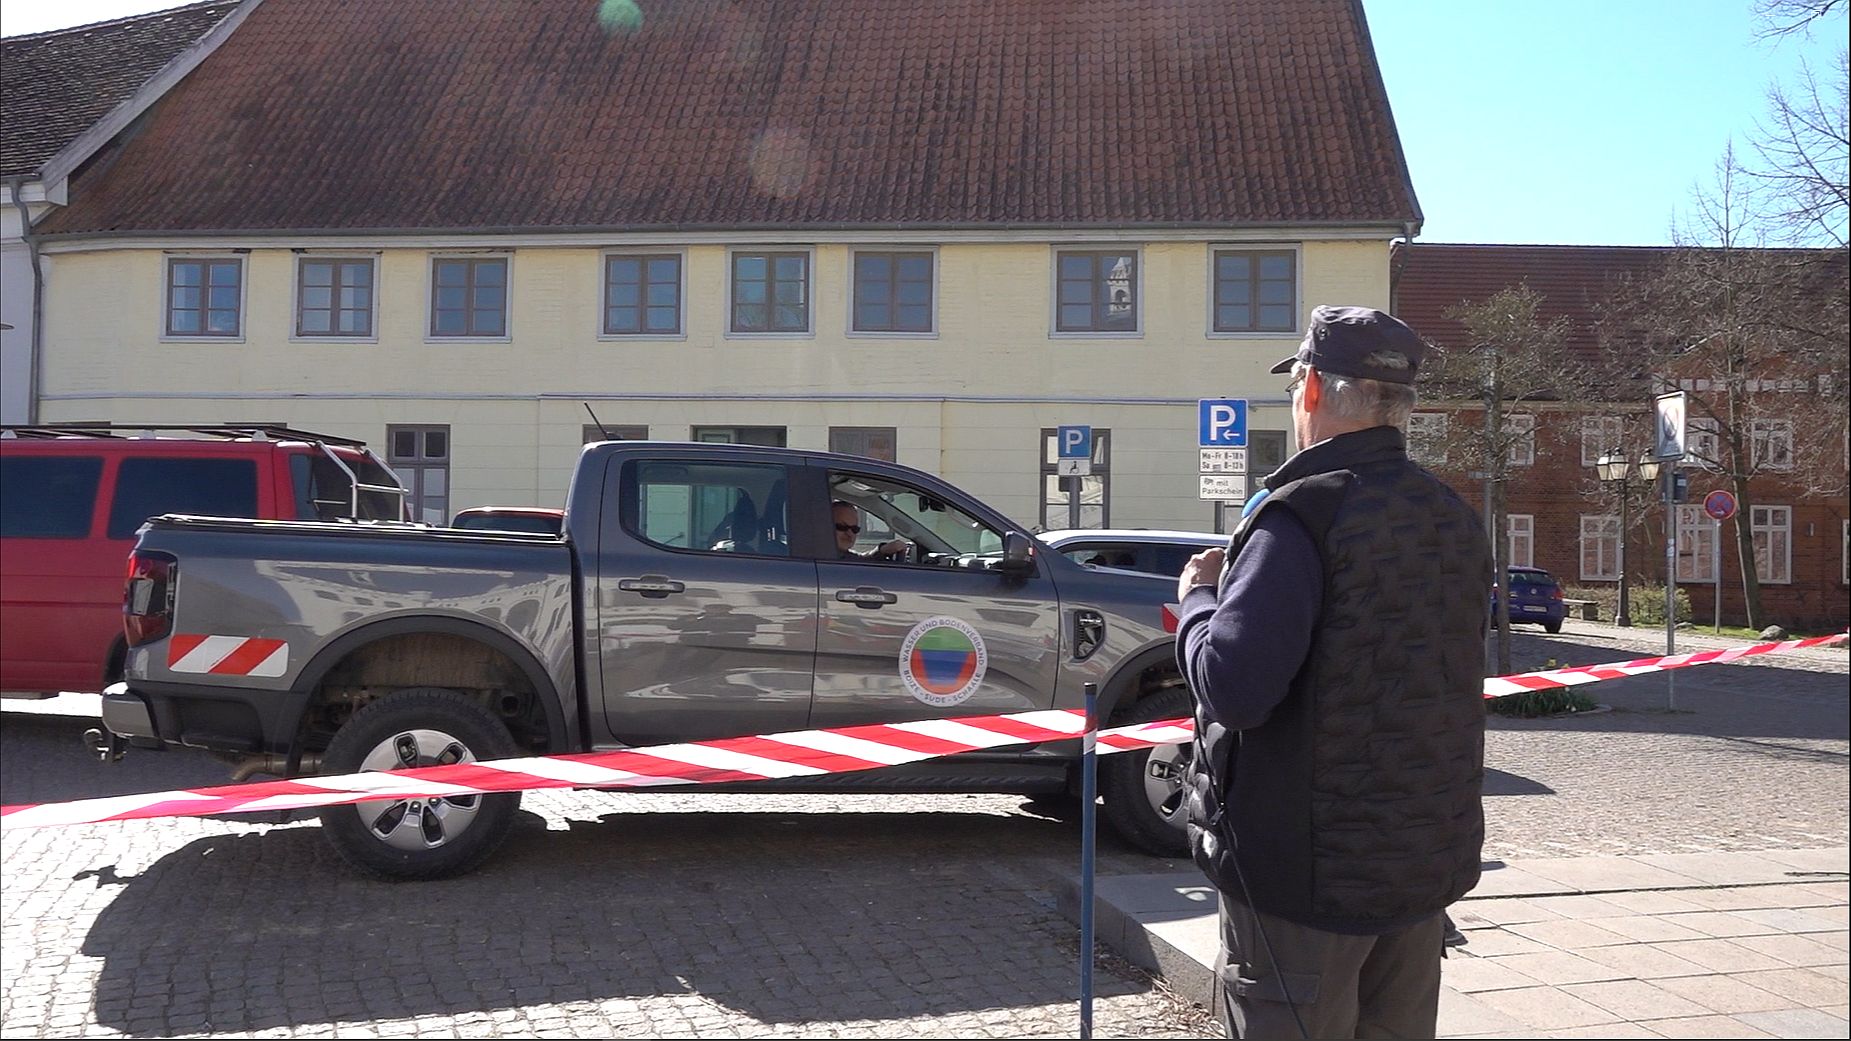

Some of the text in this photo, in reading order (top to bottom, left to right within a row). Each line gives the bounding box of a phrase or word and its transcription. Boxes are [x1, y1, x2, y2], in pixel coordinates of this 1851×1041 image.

[1210, 405, 1236, 441] P
[1065, 429, 1083, 454] P
[1202, 487, 1243, 495] Parkschein
[903, 619, 985, 666] WASSER UND BODENVERBAND
[903, 669, 921, 694] BOIZE
[924, 693, 946, 703] SUDE
[953, 673, 982, 701] SCHAALE
